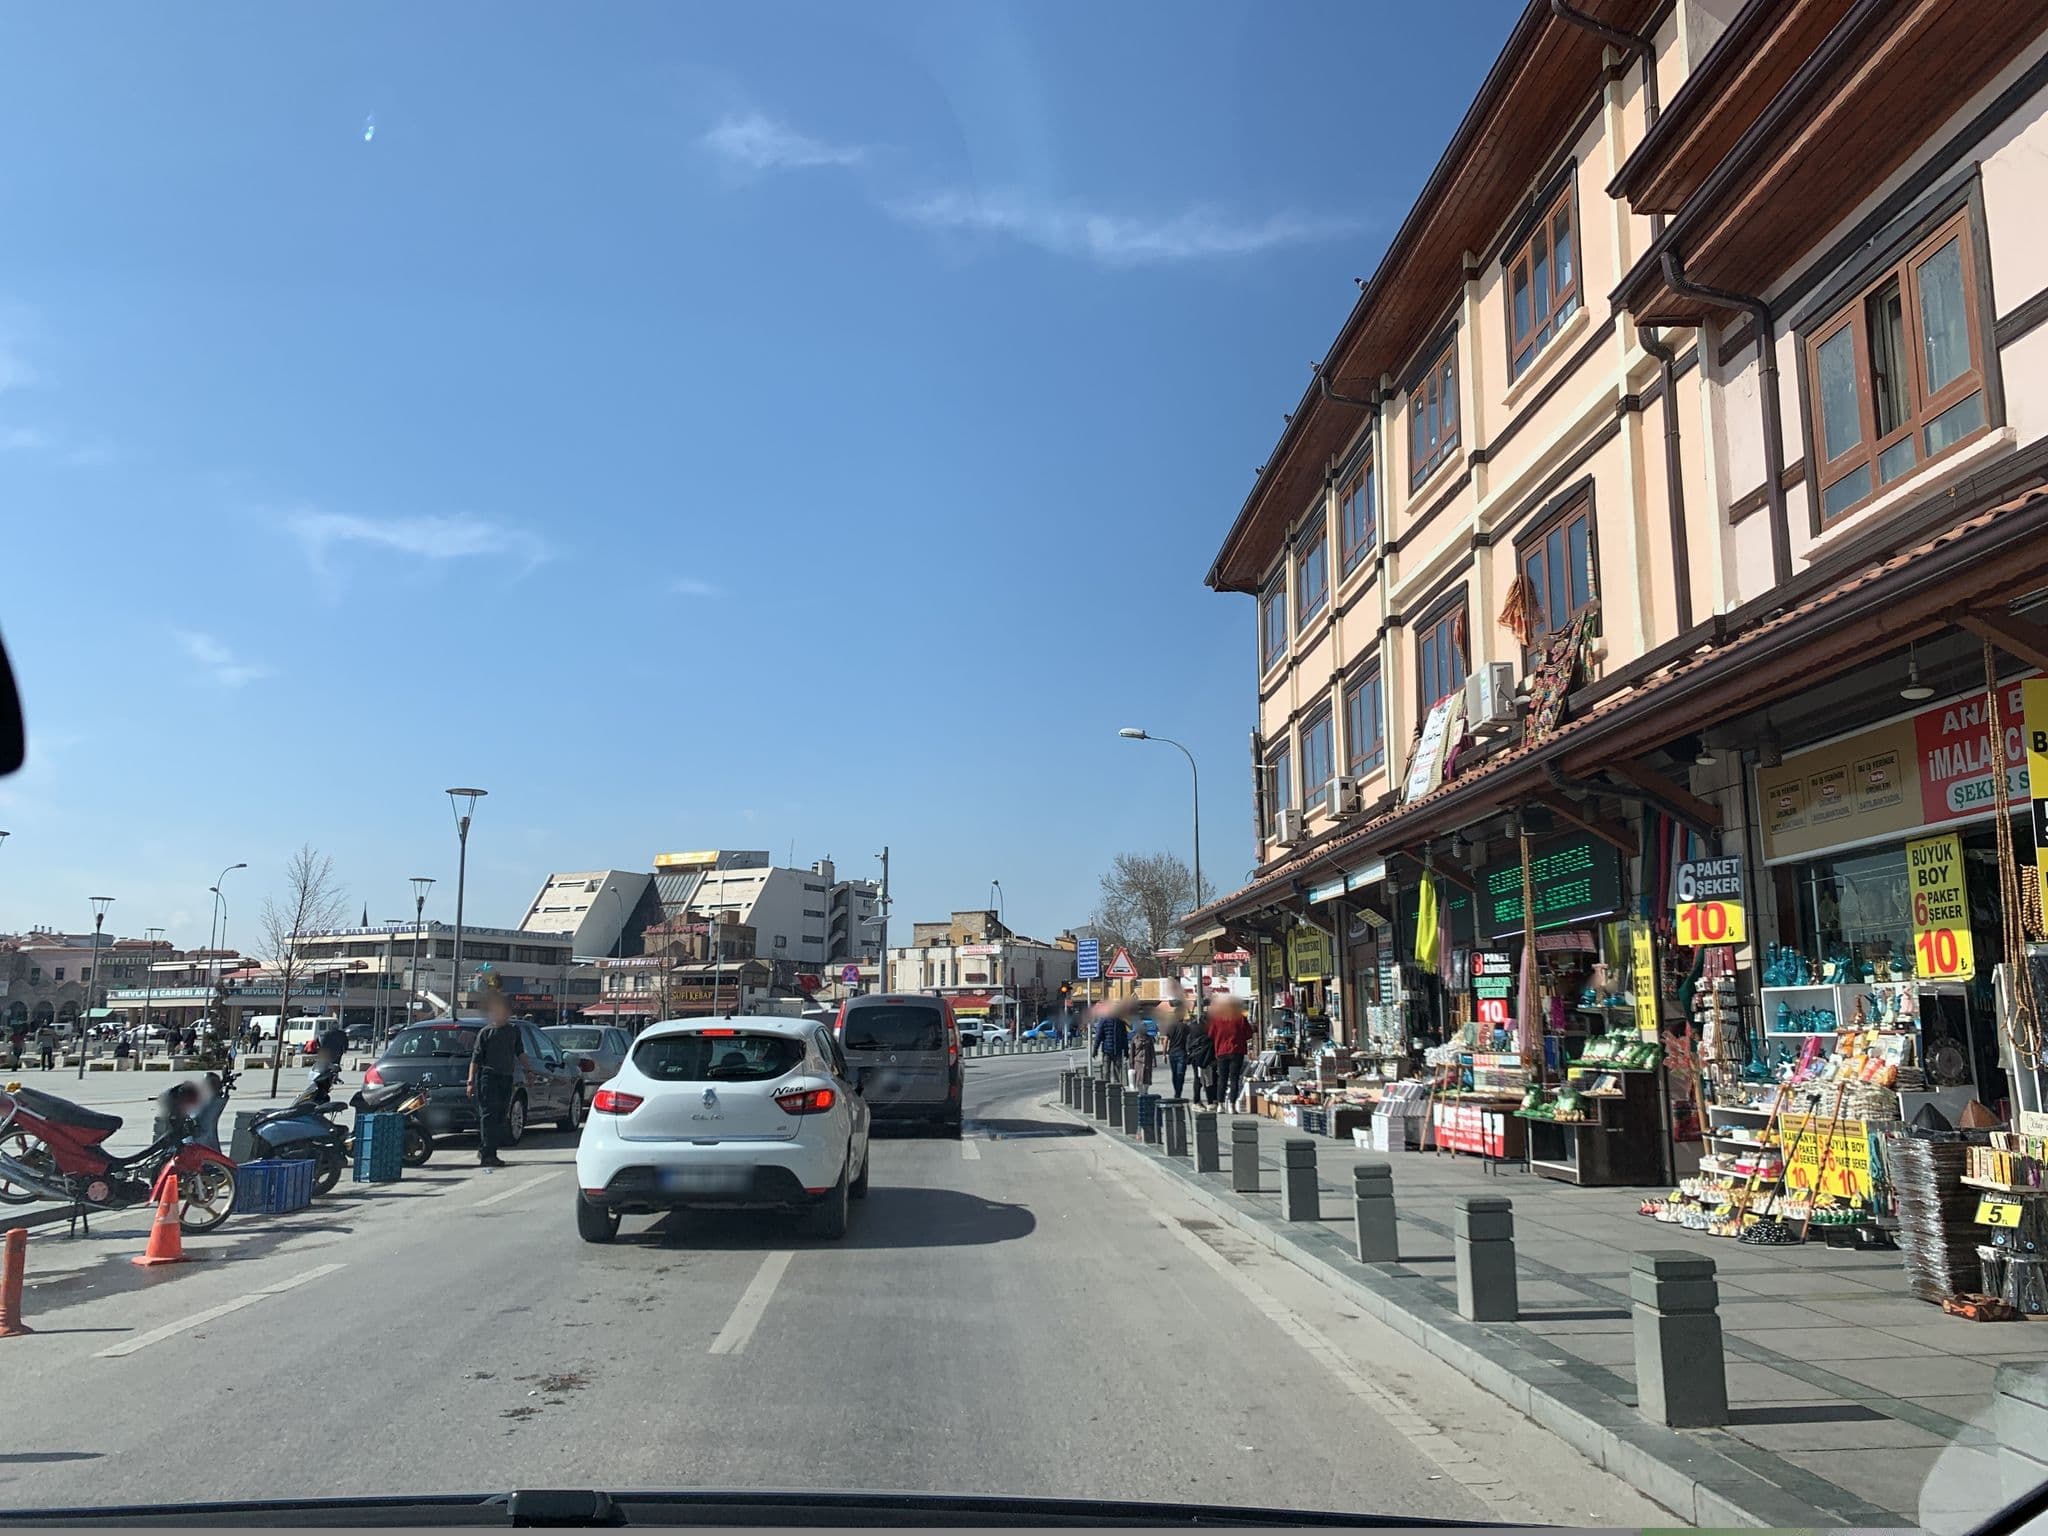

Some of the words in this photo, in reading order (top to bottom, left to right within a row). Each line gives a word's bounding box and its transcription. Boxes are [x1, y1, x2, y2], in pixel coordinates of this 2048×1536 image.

[1912, 842, 1953, 867] BÜYÜK
[1697, 859, 1739, 877] PAKET
[1918, 865, 1949, 886] BOY
[1678, 863, 1696, 901] 6
[1696, 877, 1740, 899] ŞEKER
[1928, 888, 1960, 905] PAKET
[1915, 892, 1928, 926] 6
[1929, 905, 1962, 924] ŞEKER
[1681, 901, 1726, 941] 10
[1919, 928, 1958, 974] 10
[1481, 1000, 1503, 1023] 10
[1793, 1167, 1806, 1188] 10
[1839, 1169, 1857, 1195] 10
[1988, 1205, 2003, 1223] 5
